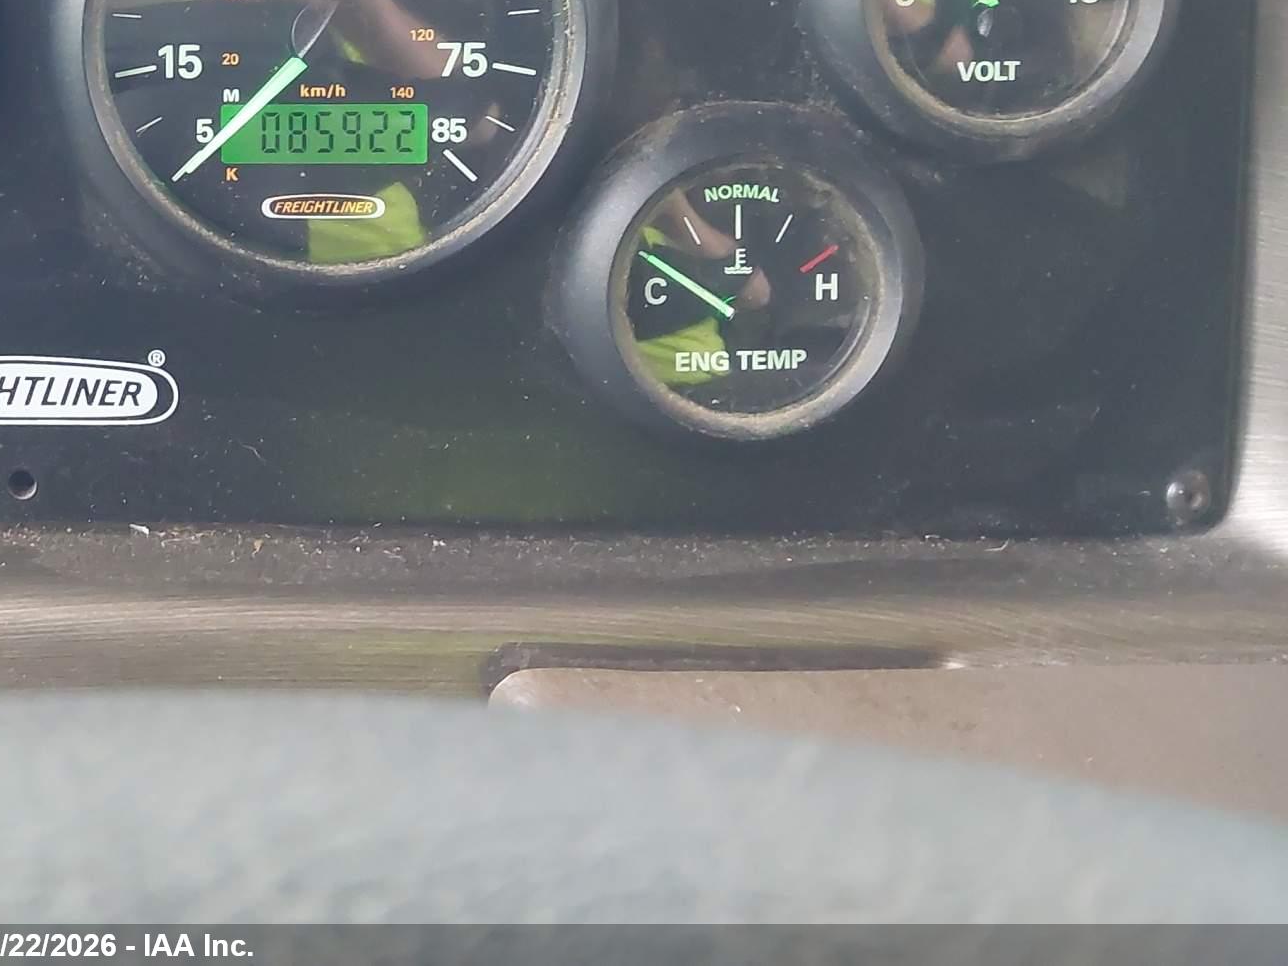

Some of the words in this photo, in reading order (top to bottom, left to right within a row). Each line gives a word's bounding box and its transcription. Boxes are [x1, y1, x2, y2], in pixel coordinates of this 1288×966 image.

[410, 28, 435, 41] 120
[158, 44, 203, 79] 15
[222, 53, 240, 66] 20
[436, 42, 488, 78] 75
[956, 60, 1021, 82] VOLT
[222, 90, 240, 103] M
[299, 84, 346, 98] km/h
[390, 86, 414, 99] 140
[195, 118, 214, 143] 5
[261, 110, 417, 155] 085922
[431, 118, 467, 144] 85
[225, 167, 240, 182] K
[703, 184, 780, 203] NORMAL
[273, 200, 374, 214] FREIGHTLINER
[644, 277, 668, 305] C
[815, 273, 839, 301] H
[674, 351, 730, 372] ENG
[735, 349, 808, 370] TEMP
